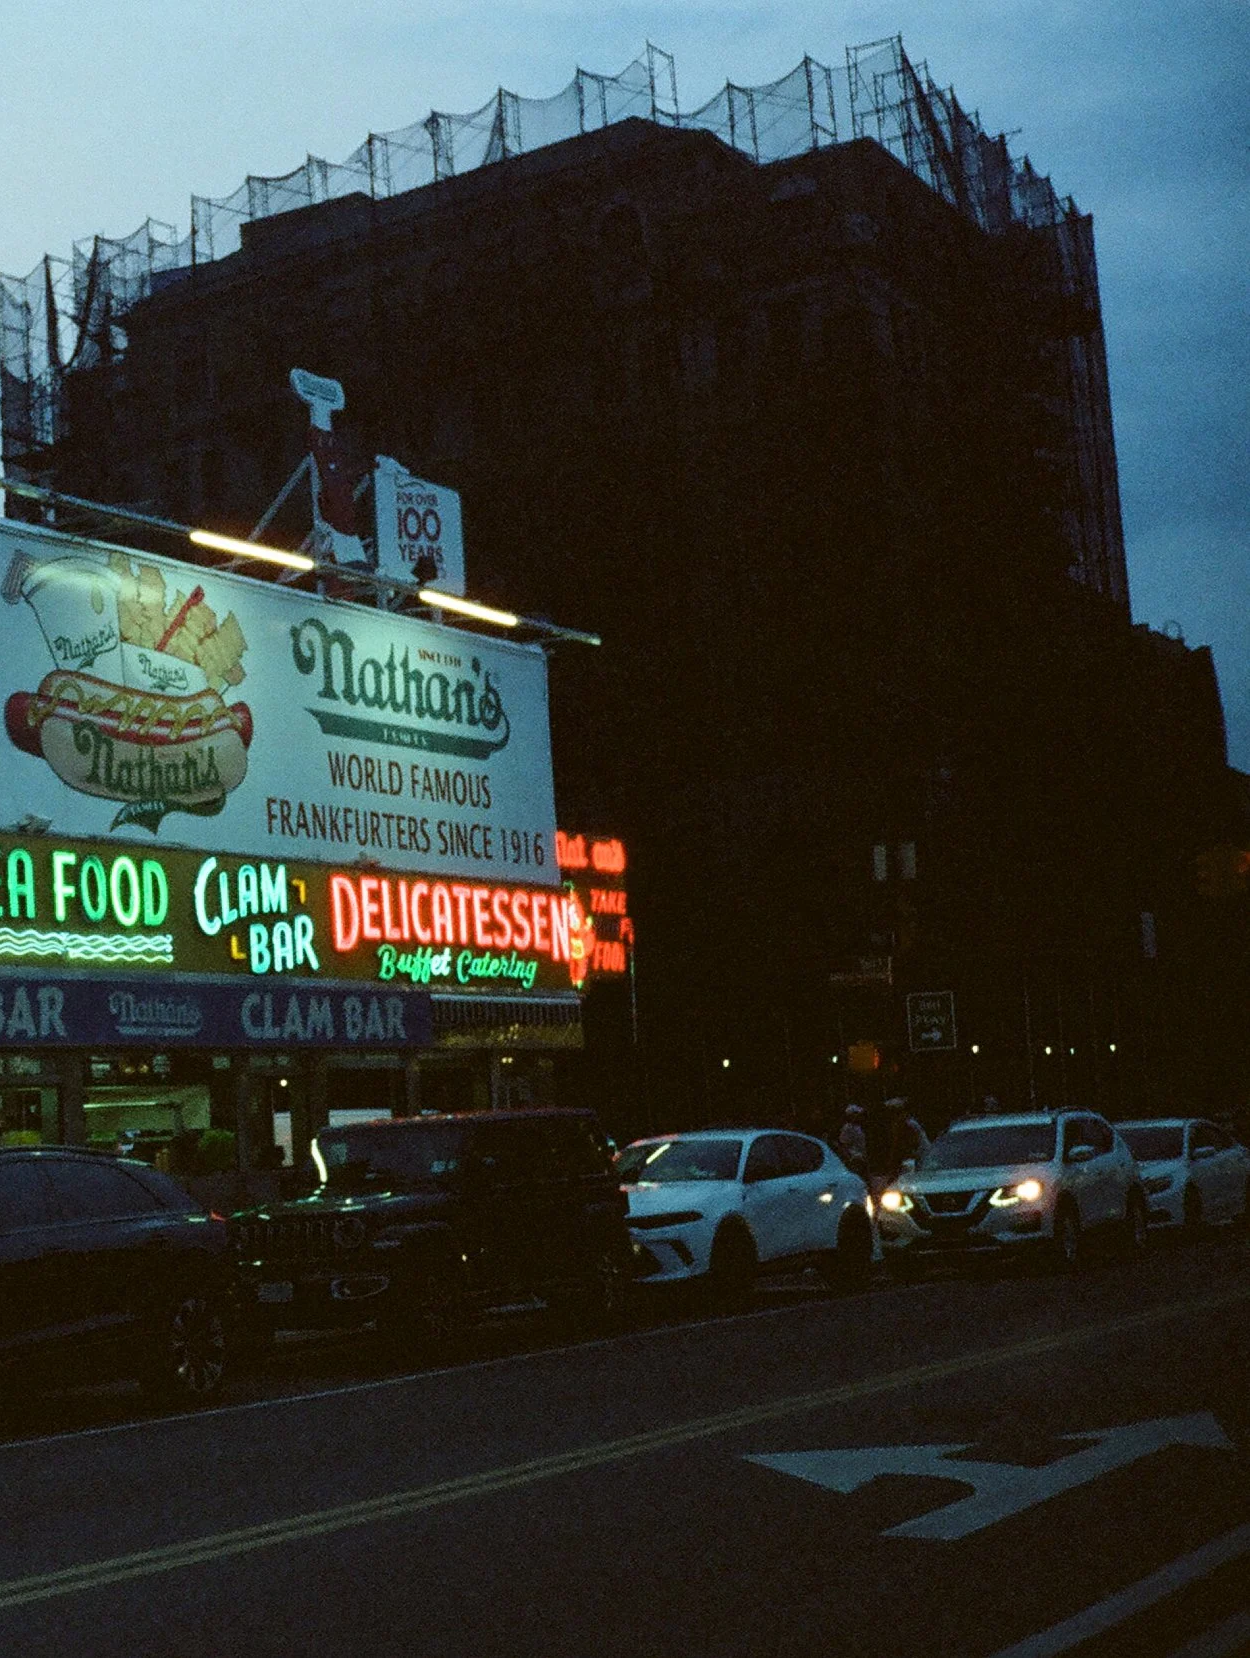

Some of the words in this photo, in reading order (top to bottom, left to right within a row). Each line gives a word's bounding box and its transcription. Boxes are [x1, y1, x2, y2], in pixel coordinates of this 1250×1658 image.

[397, 507, 442, 542] 100
[291, 618, 502, 732] Nathan's
[72, 719, 220, 797] Nathan's
[328, 750, 403, 795] WORLD
[410, 769, 492, 810] FAMOUS
[266, 797, 432, 856] FRANKFURTERS
[437, 823, 494, 862] SINCE
[500, 829, 546, 868] 1916
[52, 850, 170, 927] FOOD
[194, 856, 288, 935] CLAM
[329, 872, 571, 962] DELICATESSEN
[249, 913, 320, 975] BAR
[377, 943, 451, 981] Buffet
[456, 947, 538, 989] Catering
[109, 990, 201, 1026] Nathan's
[240, 994, 334, 1042] CLAM
[342, 996, 408, 1042] BAR
